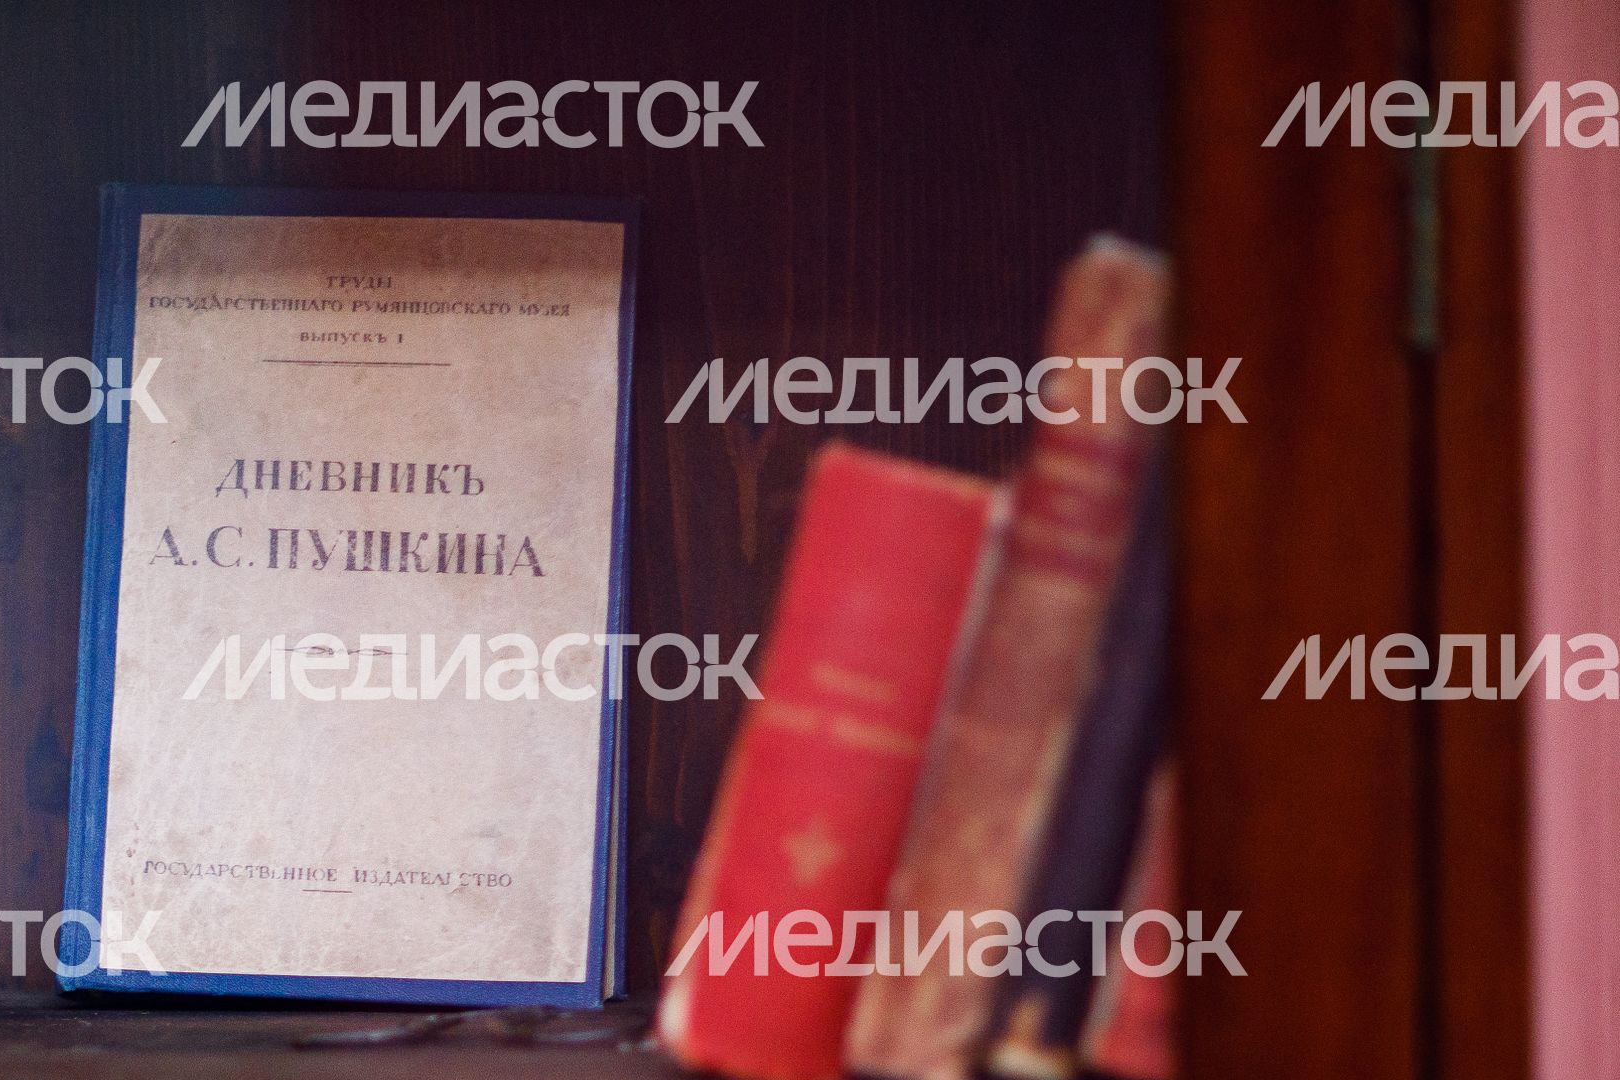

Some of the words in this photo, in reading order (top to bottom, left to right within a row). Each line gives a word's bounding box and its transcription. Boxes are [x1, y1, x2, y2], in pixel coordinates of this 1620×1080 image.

[299, 331, 387, 345] ВЫПУСКЪ
[214, 458, 485, 498] ДНЕВНИКЪ
[353, 866, 513, 888] ИЗДАТЕЛСТВО
